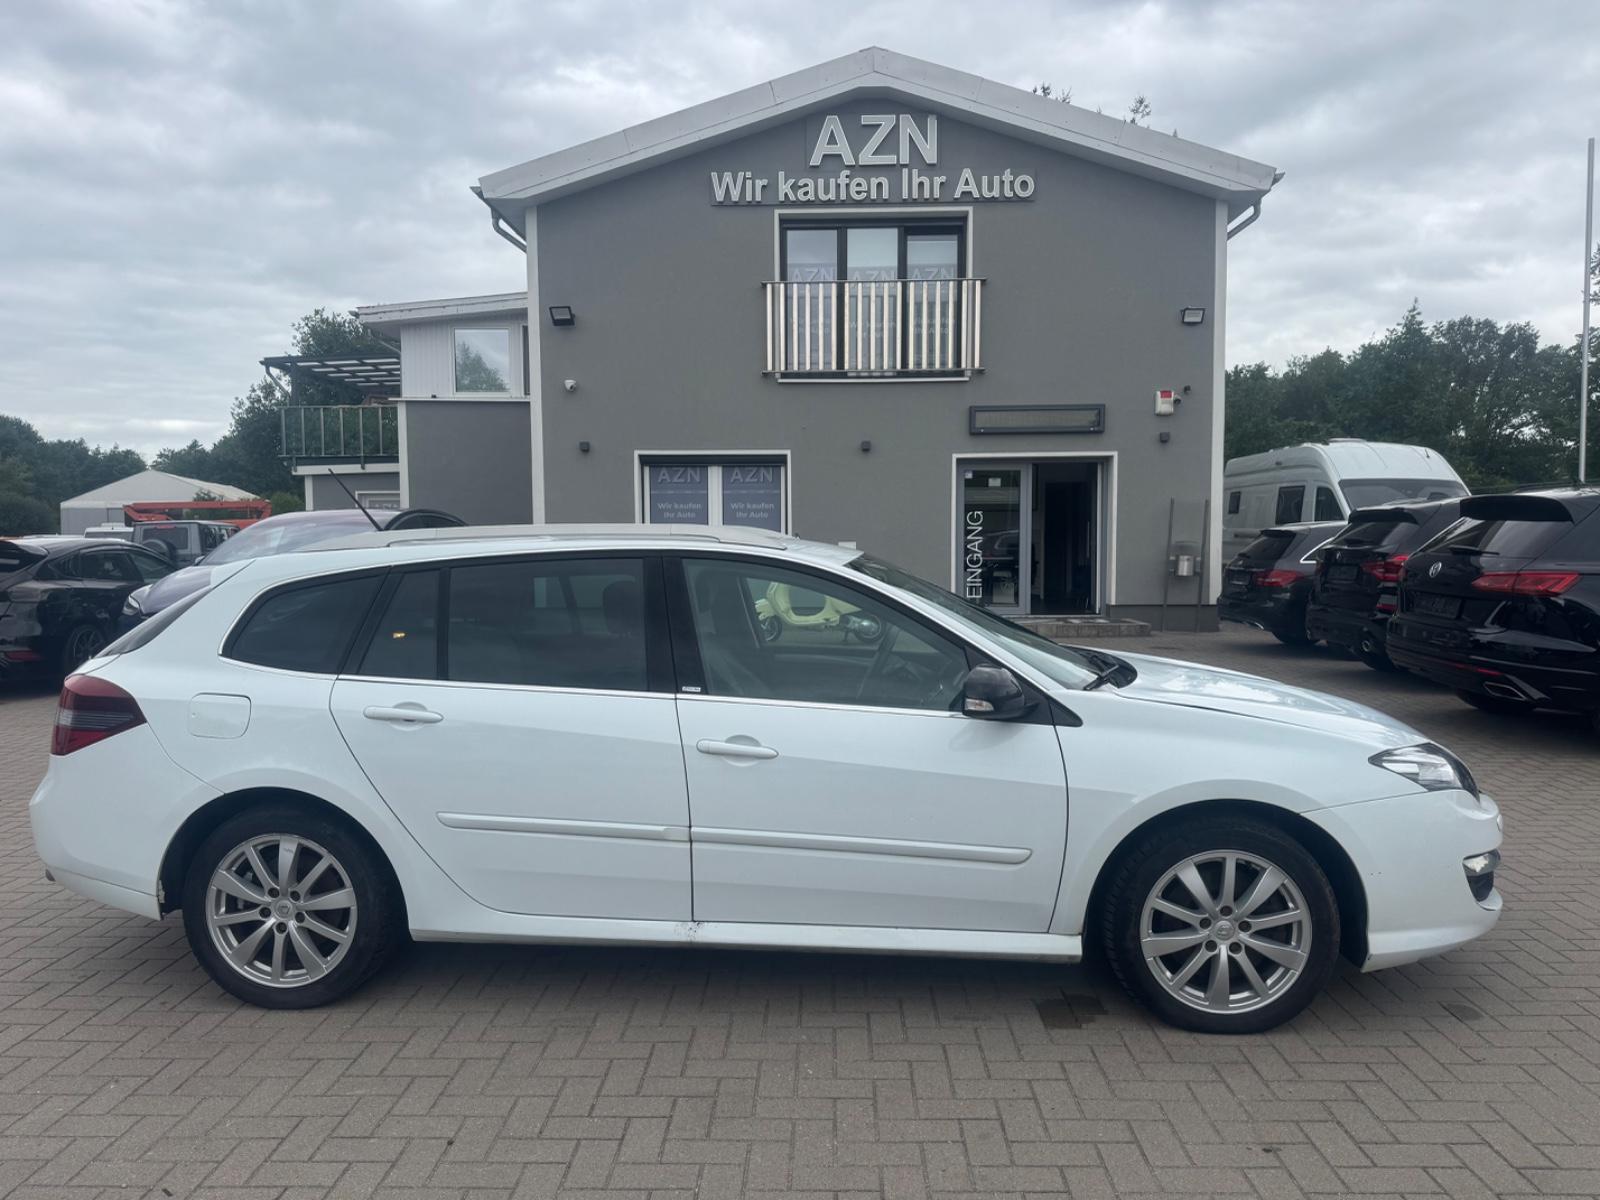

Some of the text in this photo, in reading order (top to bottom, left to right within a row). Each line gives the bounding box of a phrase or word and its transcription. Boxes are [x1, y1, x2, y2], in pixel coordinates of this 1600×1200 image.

[809, 114, 938, 167] AZN
[711, 167, 1036, 202] Wir kaufen Ihr Auto
[791, 267, 836, 282] AZN
[852, 270, 896, 287] AZN
[911, 267, 955, 281] AZN
[657, 466, 700, 483] AZN
[730, 466, 773, 483] AZN
[657, 502, 702, 510] Wir kaufen
[730, 502, 775, 510] Wir kaufen
[663, 511, 697, 519] Ihr Auto
[736, 511, 770, 519] Ihr Auto
[966, 510, 984, 599] EINGANG
